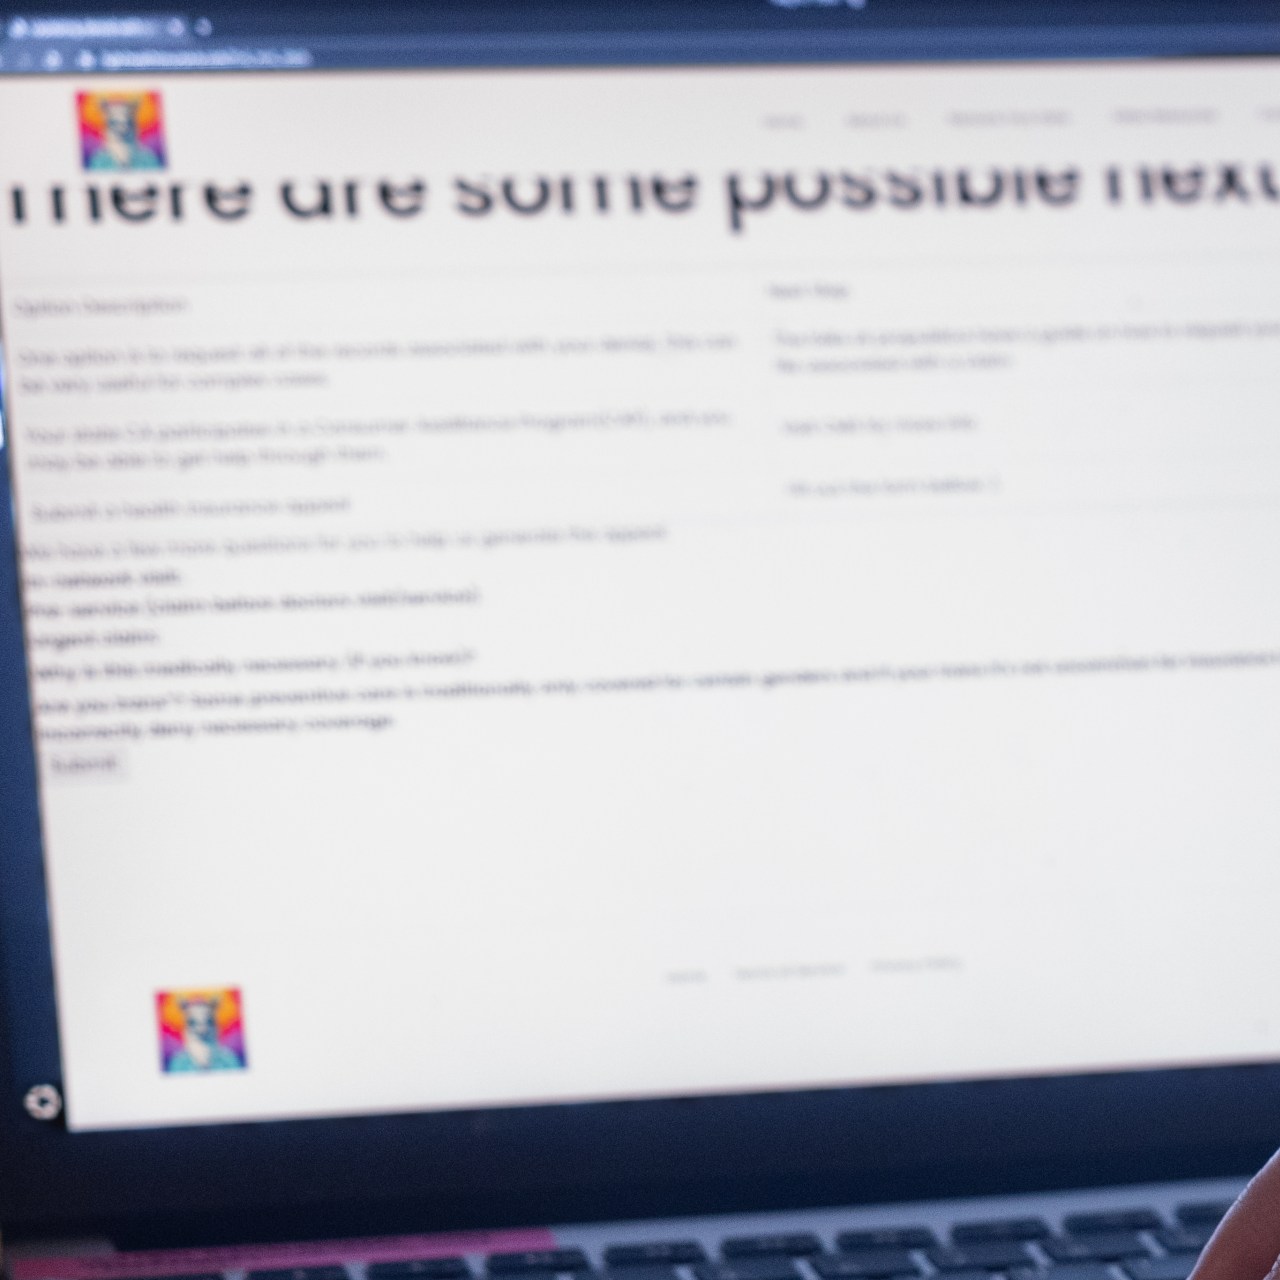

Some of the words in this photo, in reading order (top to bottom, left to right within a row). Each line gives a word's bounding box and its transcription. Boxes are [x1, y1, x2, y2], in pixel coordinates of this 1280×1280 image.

[278, 175, 425, 222] are
[452, 173, 699, 218] some
[726, 165, 1080, 234] possible
